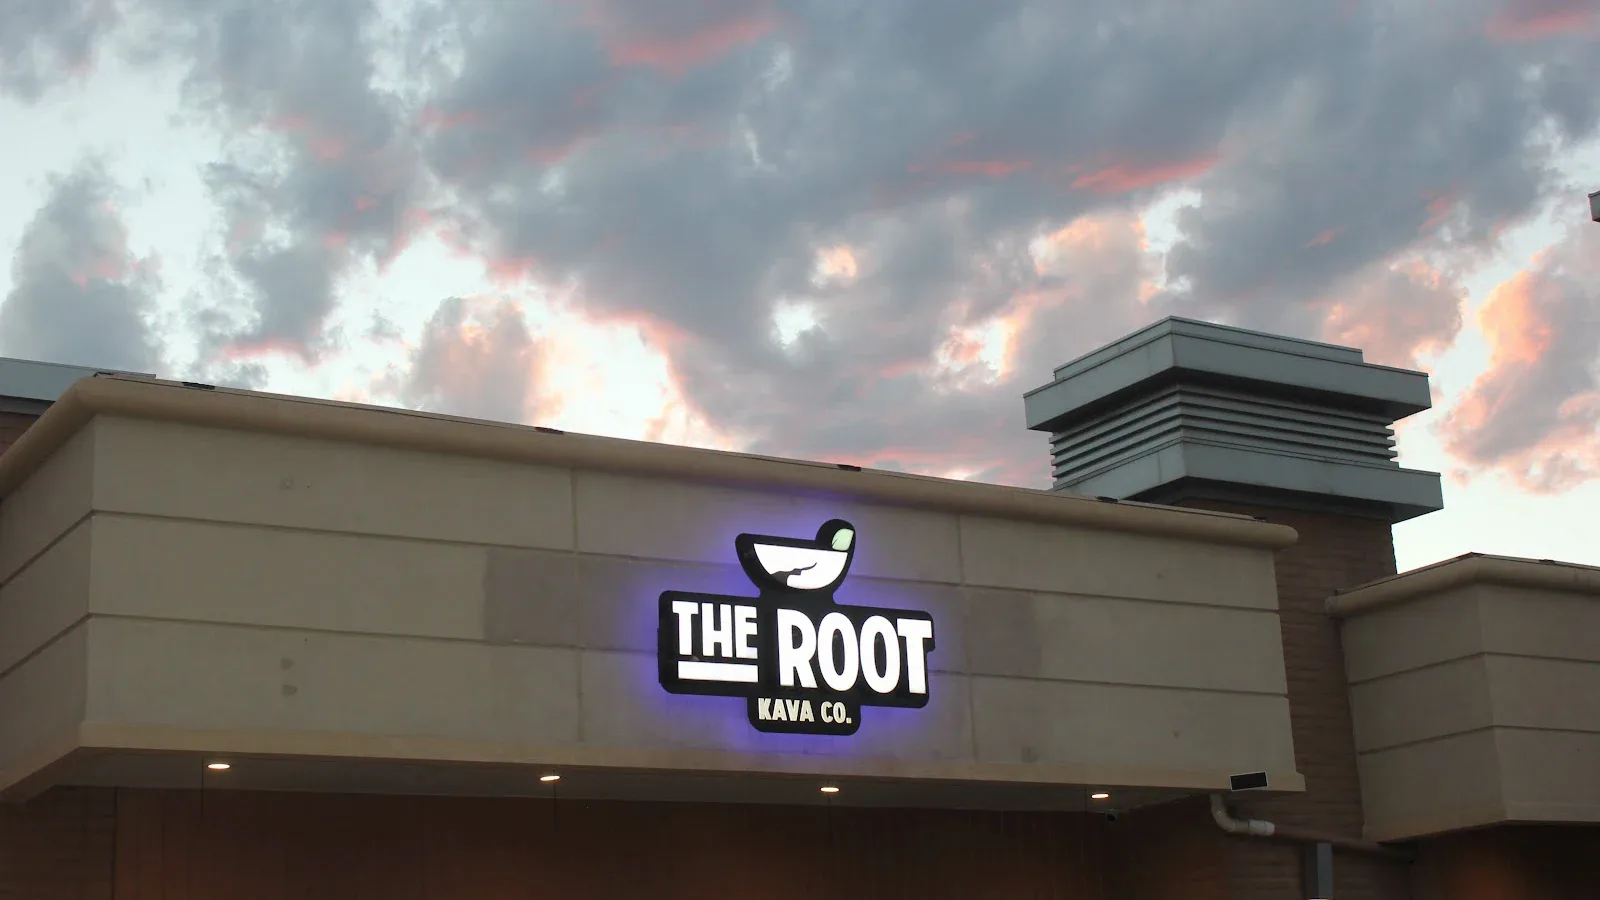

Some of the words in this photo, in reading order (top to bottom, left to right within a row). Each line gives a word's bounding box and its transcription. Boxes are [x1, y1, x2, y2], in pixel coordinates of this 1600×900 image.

[672, 600, 758, 659] THE
[776, 608, 933, 694] ROOT
[758, 697, 815, 722] KAVA
[820, 701, 852, 724] CO.
